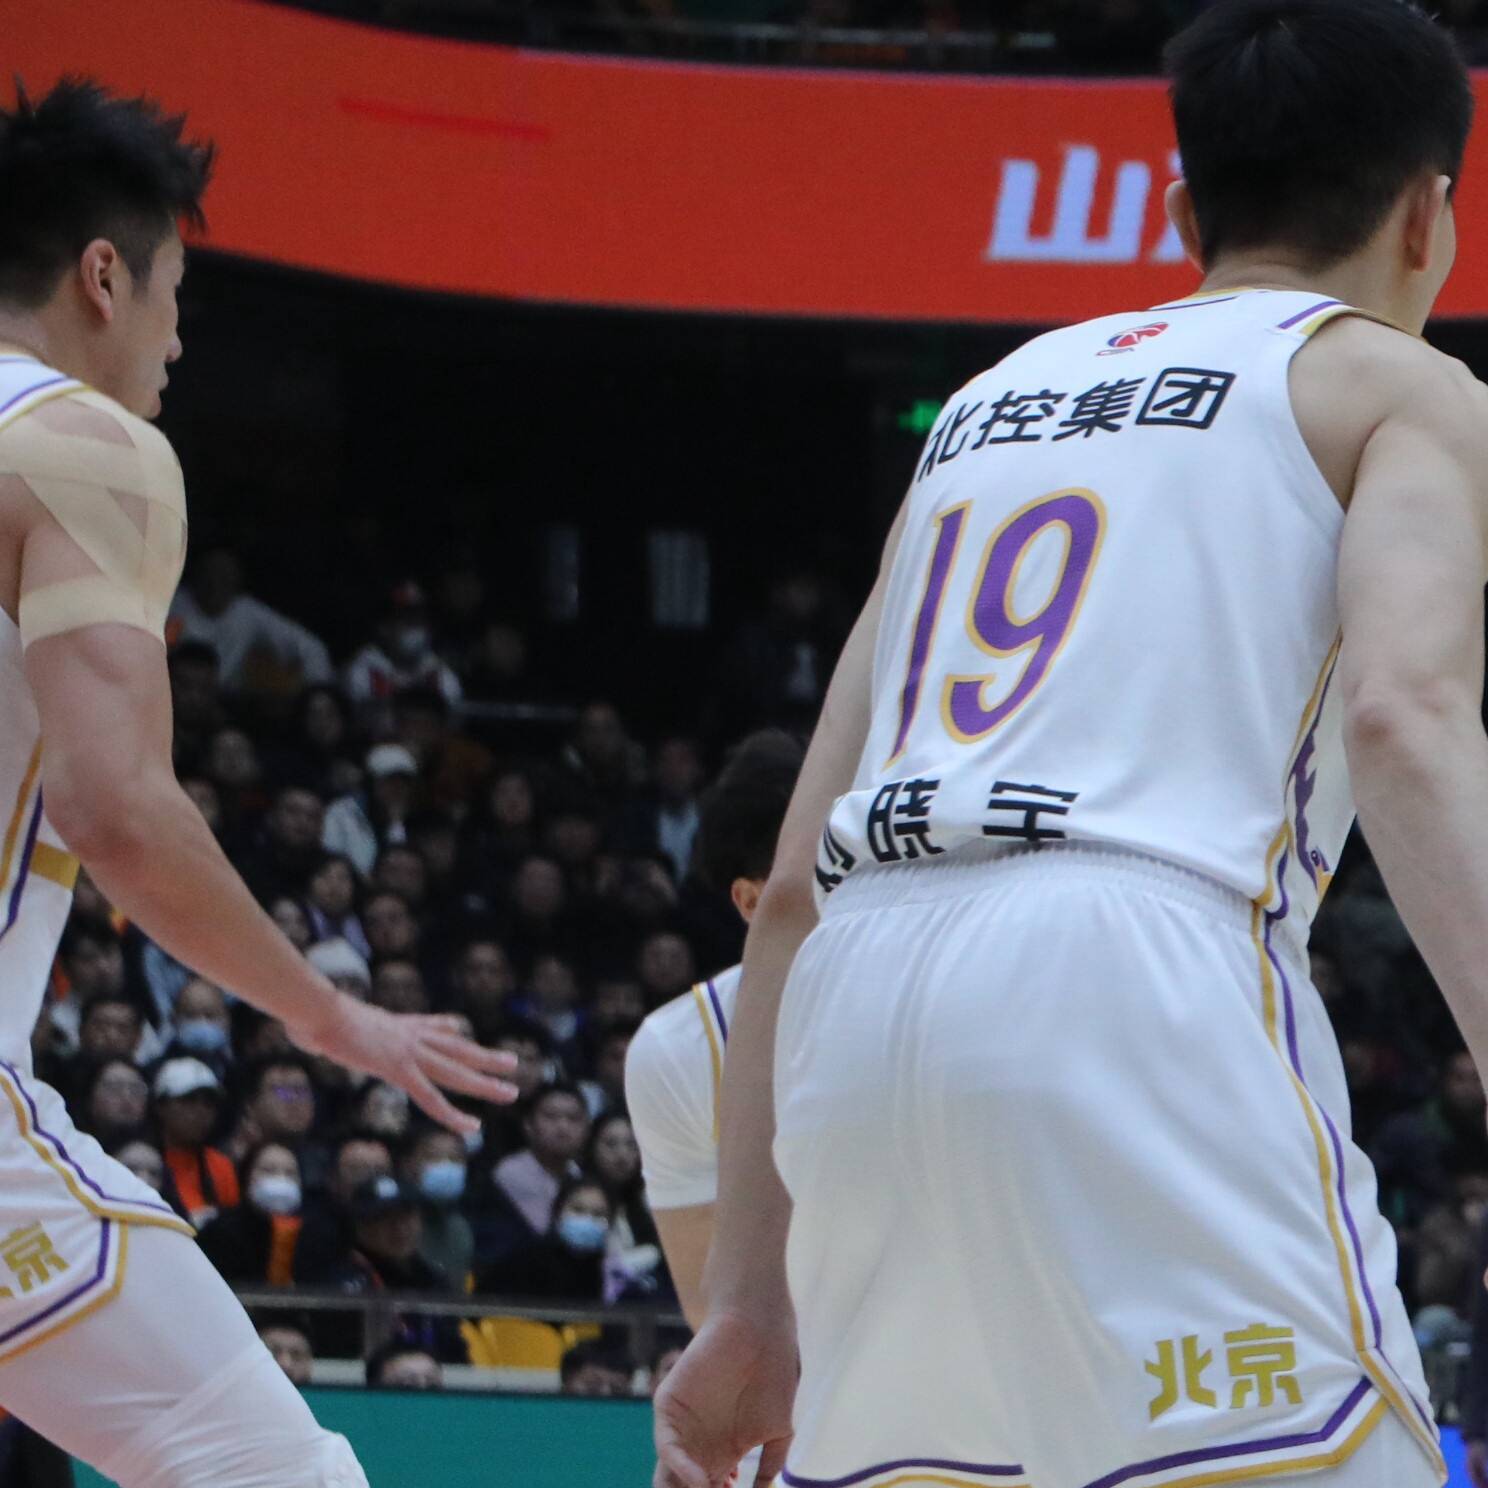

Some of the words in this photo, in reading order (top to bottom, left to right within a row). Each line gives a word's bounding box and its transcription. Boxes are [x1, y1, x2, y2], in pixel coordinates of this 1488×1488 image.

[985, 143, 1188, 263] 山
[917, 367, 1236, 482] 北控集团
[882, 487, 1107, 771] 19
[0, 1220, 70, 1298] 京
[1144, 1323, 1303, 1420] 北京
